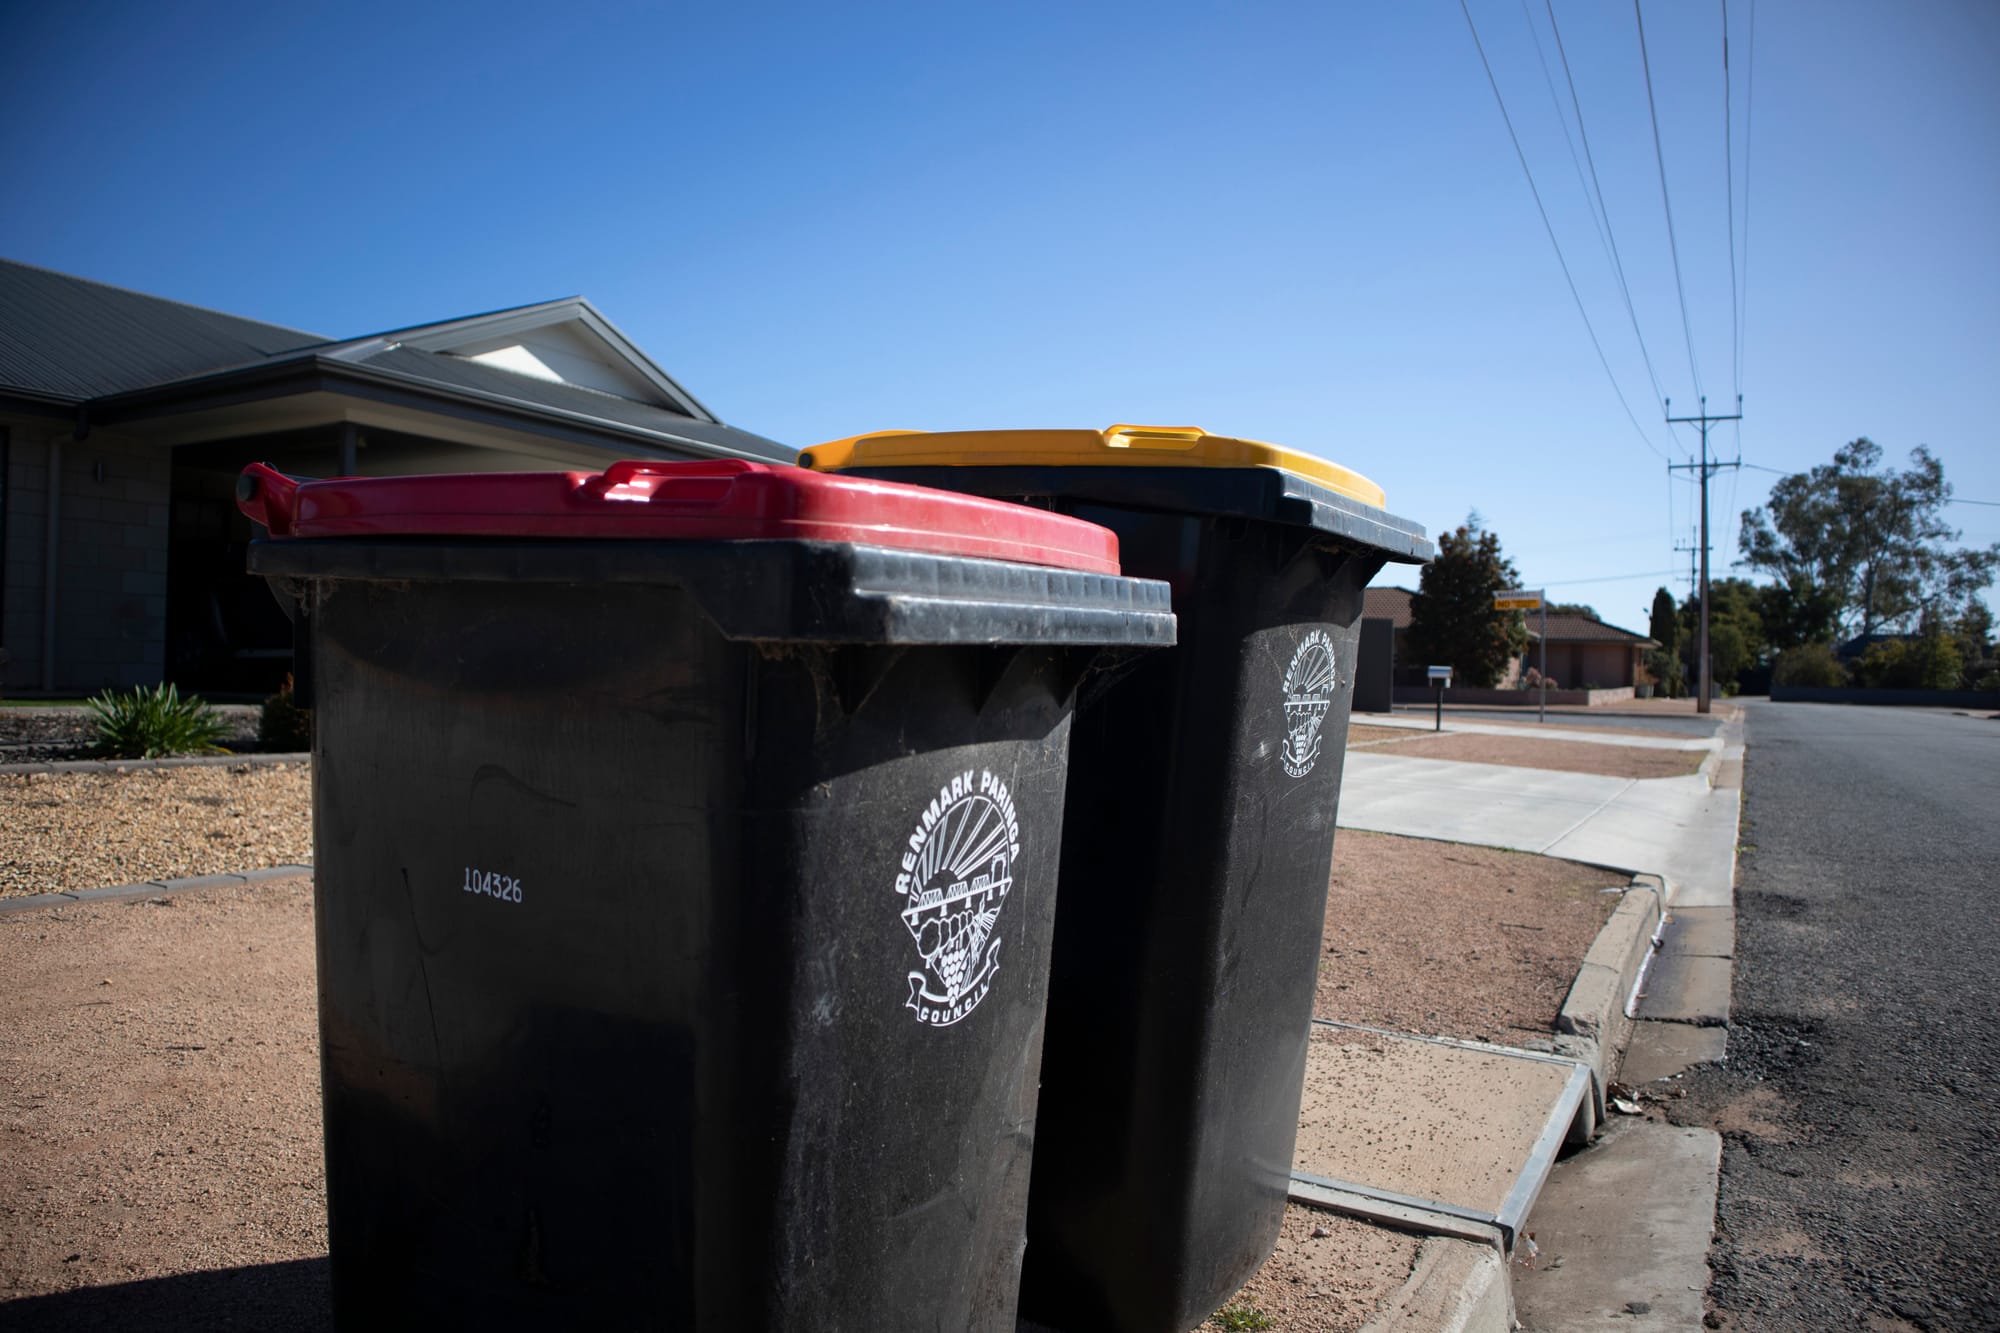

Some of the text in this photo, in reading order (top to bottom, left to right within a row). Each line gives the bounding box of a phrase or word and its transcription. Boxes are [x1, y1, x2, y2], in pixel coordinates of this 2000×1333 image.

[1282, 629, 1321, 692] RENMARK
[1285, 761, 1315, 777] COUNCIL
[895, 770, 1019, 895] RENMARK PARINGA
[464, 867, 522, 903] 104326
[920, 982, 988, 1024] COUNCIL
